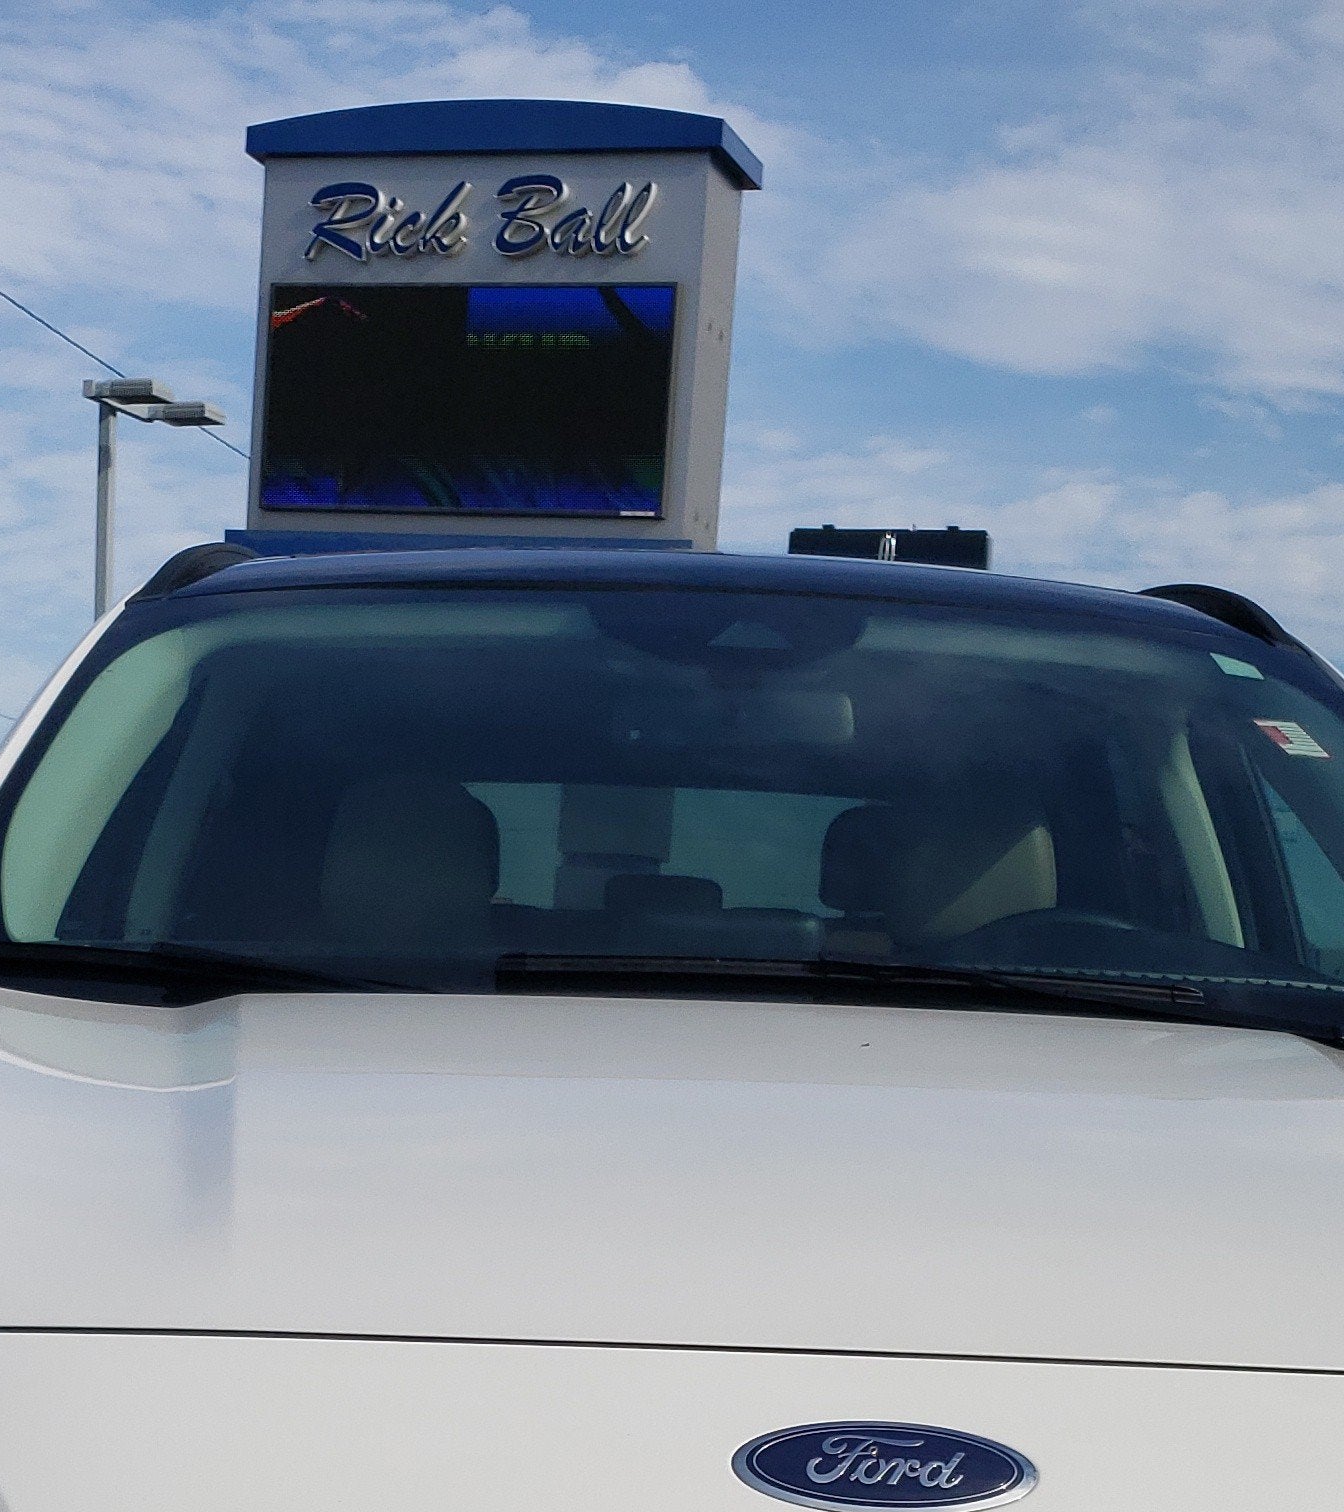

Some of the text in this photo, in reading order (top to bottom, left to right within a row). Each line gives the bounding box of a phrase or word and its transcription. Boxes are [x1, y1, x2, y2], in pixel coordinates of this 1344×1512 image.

[302, 173, 658, 264] Rick Ball
[805, 1433, 964, 1489] Ford
